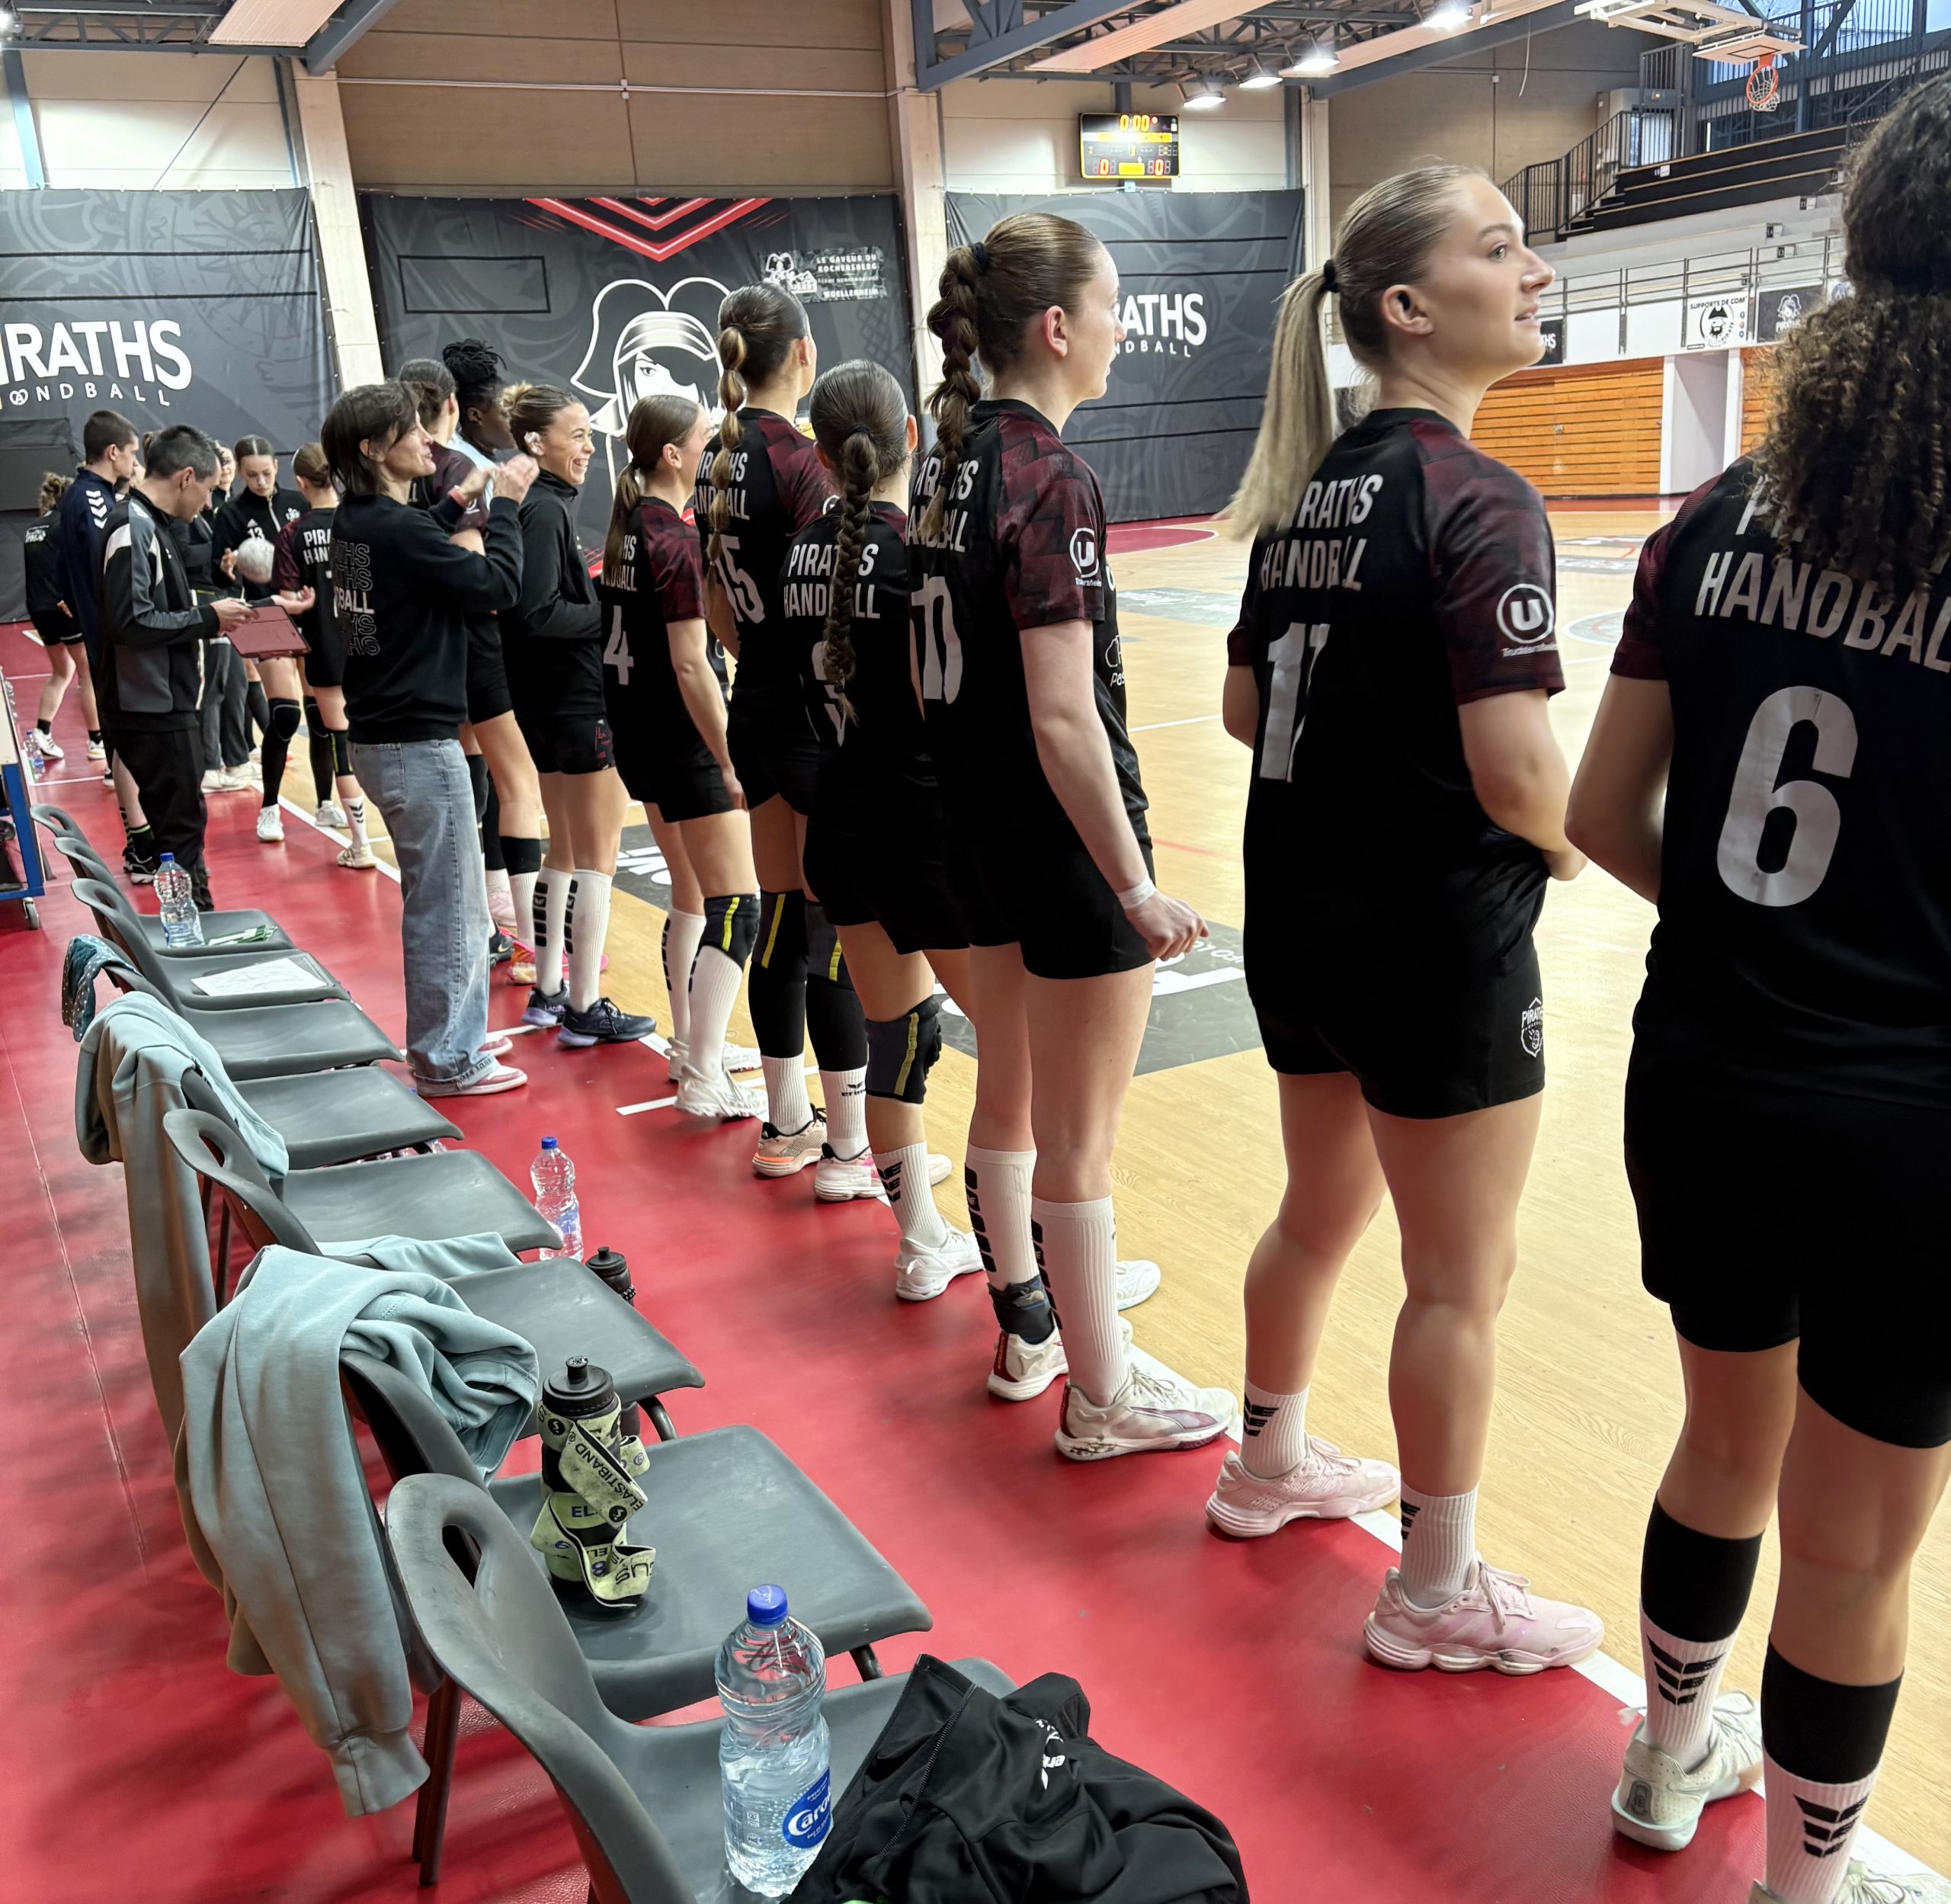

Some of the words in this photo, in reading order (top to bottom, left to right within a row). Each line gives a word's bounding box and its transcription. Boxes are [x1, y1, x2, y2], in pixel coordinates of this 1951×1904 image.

[0, 383, 170, 408] ANDBALL
[787, 543, 879, 578] PIRAS
[783, 582, 881, 619] HANDLL
[1510, 598, 1542, 632] U
[604, 605, 634, 686] 4
[1716, 684, 1859, 908] 6
[575, 1442, 645, 1512] ELASTIBAND
[570, 1505, 598, 1518] EL
